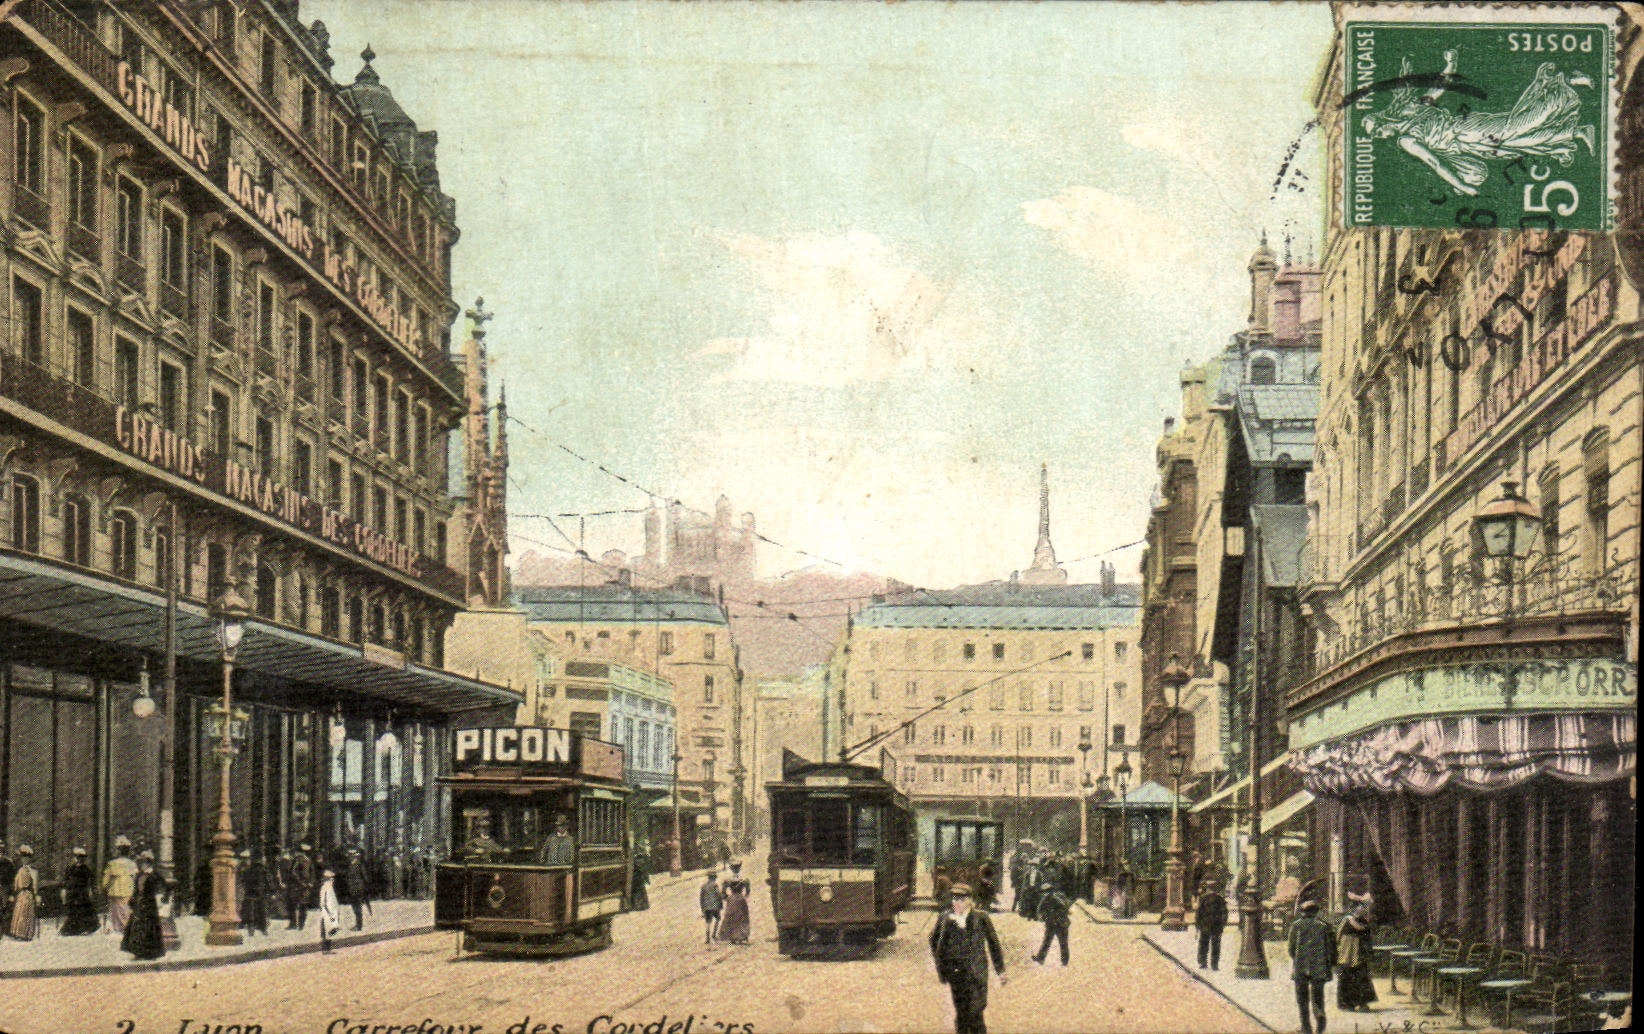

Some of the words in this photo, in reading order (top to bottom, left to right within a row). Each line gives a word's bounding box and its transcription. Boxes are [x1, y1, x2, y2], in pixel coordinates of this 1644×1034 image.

[1508, 34, 1592, 51] POSTES
[118, 61, 209, 171] GRANDS
[228, 157, 313, 259] MAGASINS
[1355, 136, 1375, 223] REPUBLIQUE
[116, 406, 206, 482] GRANDS
[227, 459, 311, 528] MAGASINS
[456, 728, 570, 762] PICON
